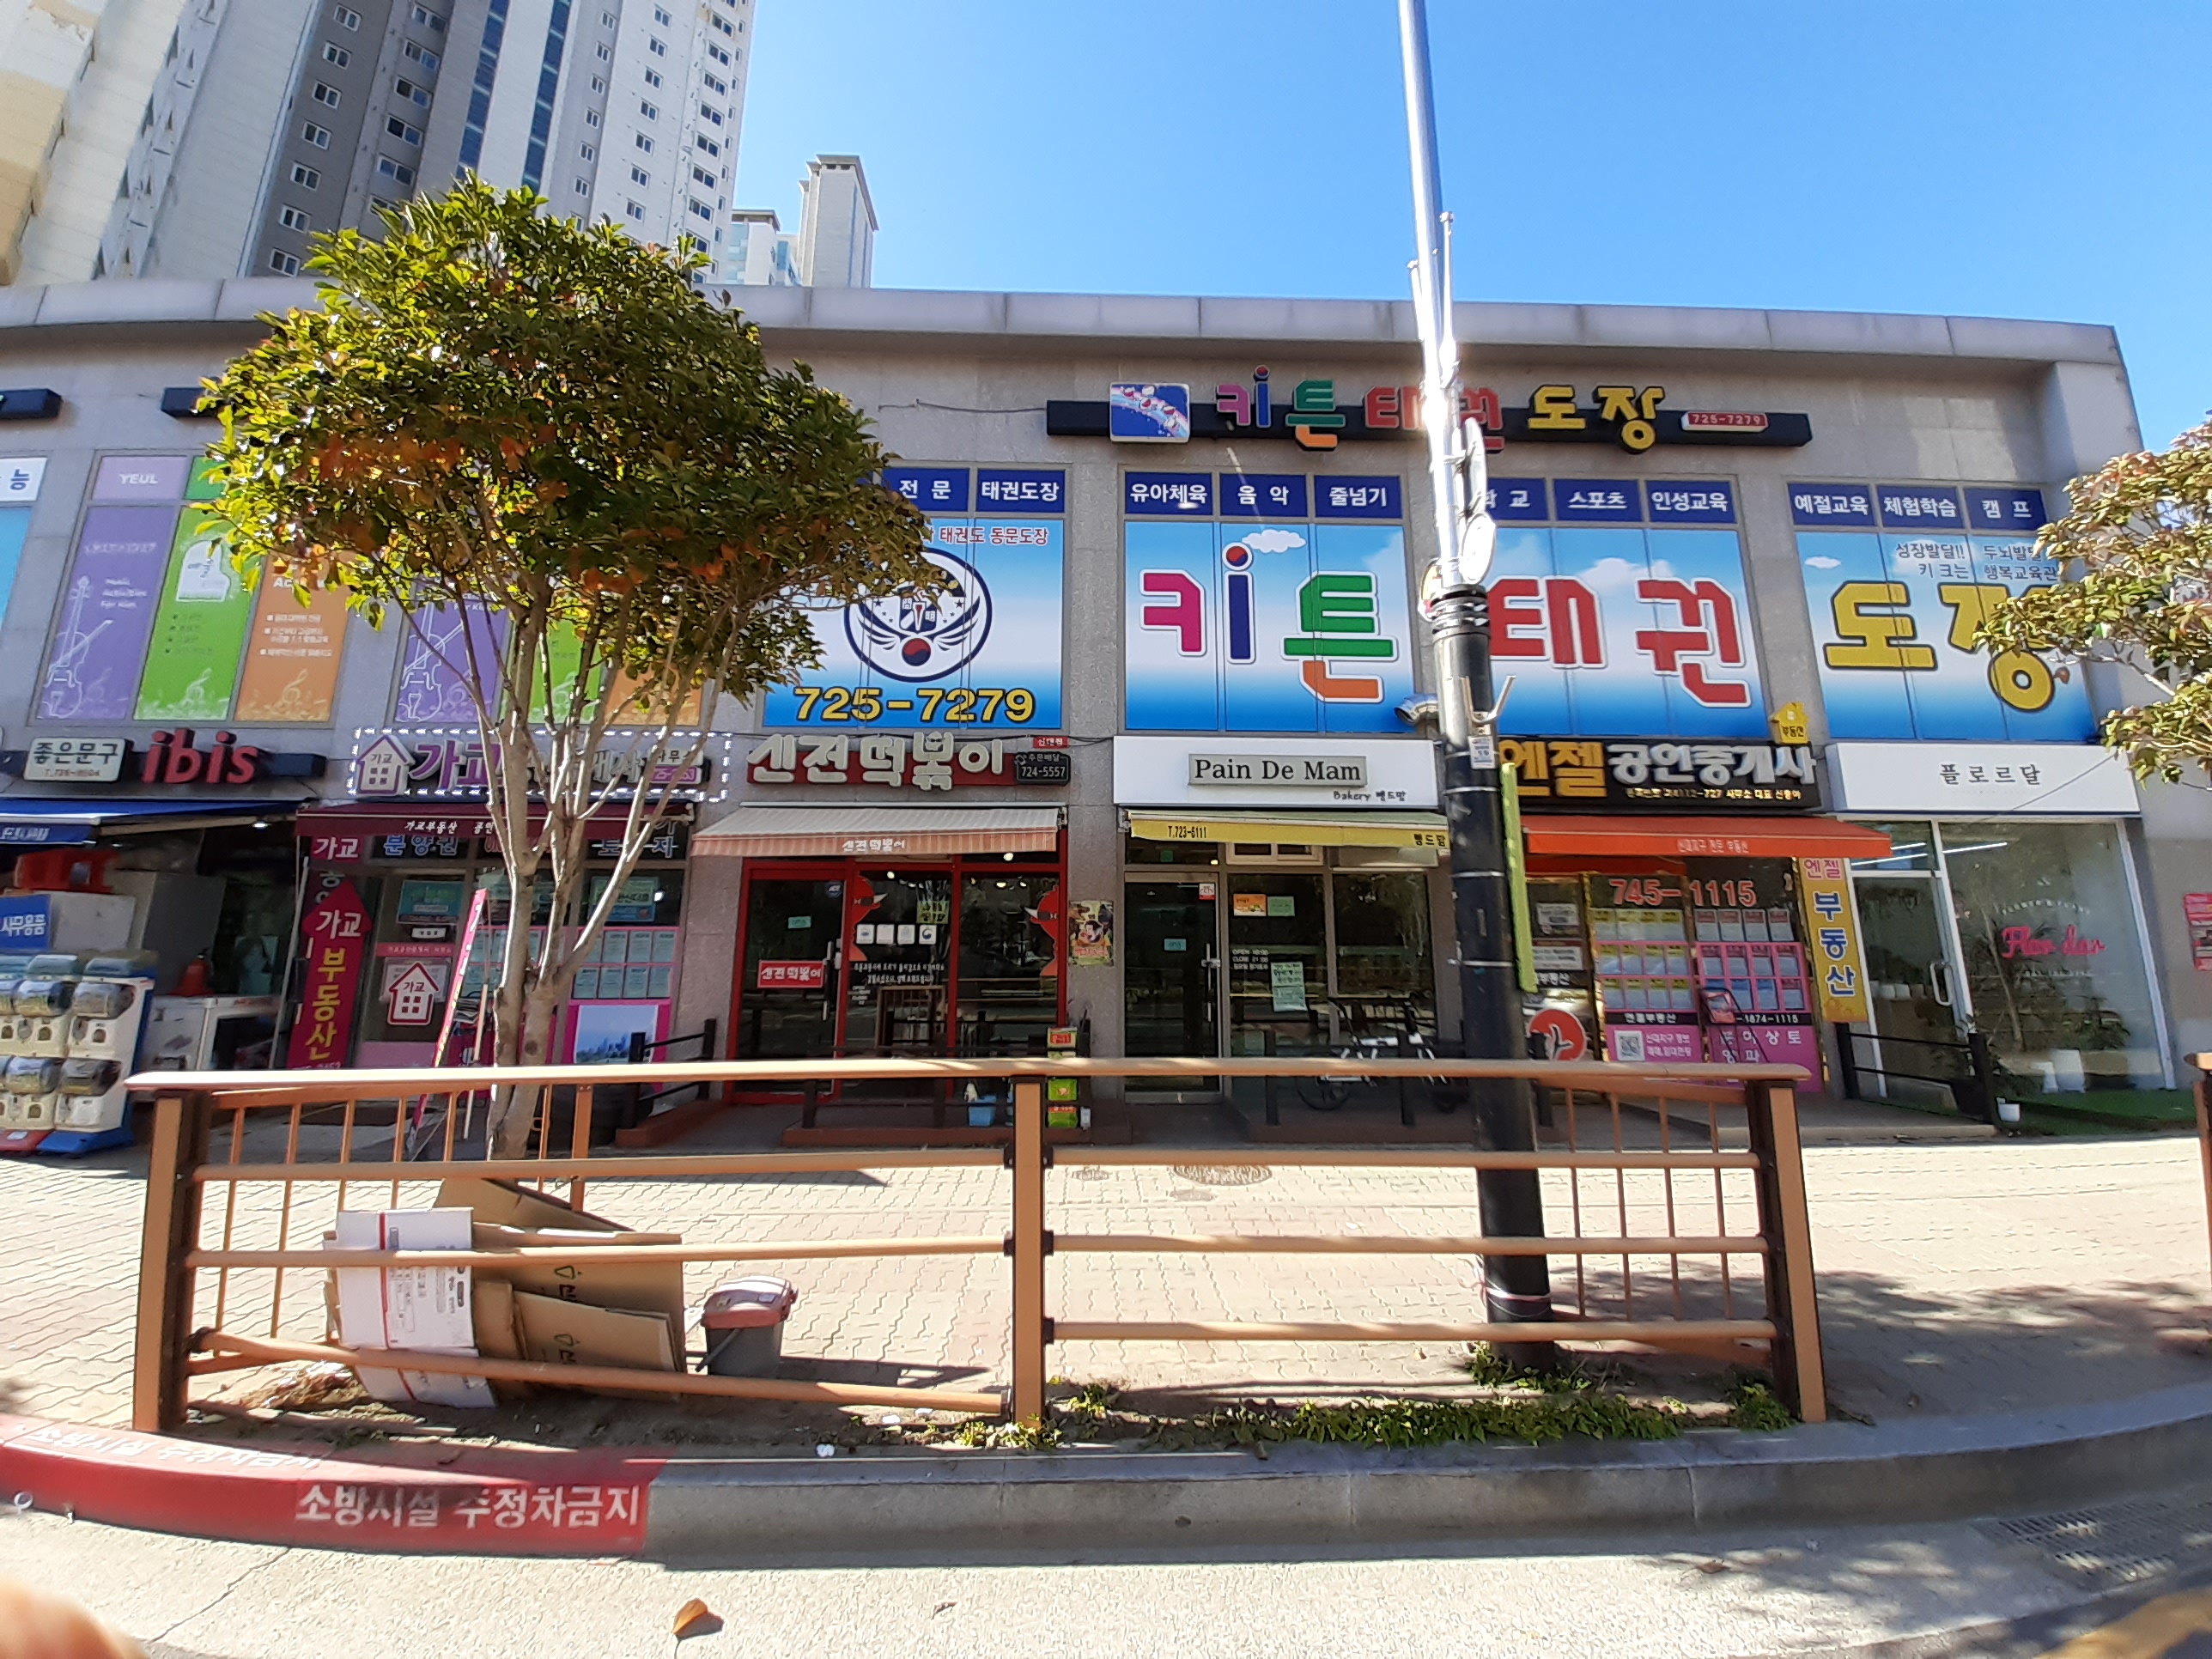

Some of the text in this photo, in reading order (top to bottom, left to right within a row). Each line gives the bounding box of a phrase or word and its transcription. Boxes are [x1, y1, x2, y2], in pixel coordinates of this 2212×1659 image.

[1691, 413, 1761, 426] 725-7279
[120, 473, 158, 485] YEUL
[981, 482, 1060, 501] 태권도장
[1130, 483, 1207, 503] 유아체육
[1329, 487, 1388, 507] 줄넘기
[1568, 491, 1627, 510] 스포츠
[1651, 492, 1728, 512] 인성교육
[1795, 494, 1869, 514] 예절교육
[1884, 497, 1957, 517] 체험학습
[939, 526, 985, 544] 태권도
[990, 527, 1048, 545] 동문도장
[1984, 564, 2058, 581] 행복교육관
[1488, 578, 1750, 706] 태권
[793, 687, 1034, 722] 725-7279
[1782, 726, 1804, 738] 부동산
[33, 742, 118, 764] 좋은문구
[142, 727, 258, 784] ibis
[372, 754, 392, 764] 가교
[746, 732, 1003, 791] 신전떡볶이
[1021, 766, 1066, 778] 724-5557
[1194, 759, 1361, 781] Pain De Mam
[1498, 739, 1607, 797] 엔젤
[1607, 744, 1816, 785] 공인중개사
[1939, 763, 2042, 787] 플로르달
[1334, 790, 1371, 801] Bakery
[404, 821, 458, 835] 가교부동산
[313, 836, 359, 860] 가교
[842, 840, 906, 853] 신전떡볶이
[1804, 859, 1841, 878] 엔젤
[1610, 878, 1757, 907] 745-1115
[0, 914, 46, 937] 사무용품
[315, 909, 362, 939] 가교
[1813, 891, 1856, 997] 부동산
[404, 981, 425, 993] 가교
[305, 947, 346, 1060] 부동산
[295, 1486, 640, 1528] 소방시설 주정차금지
